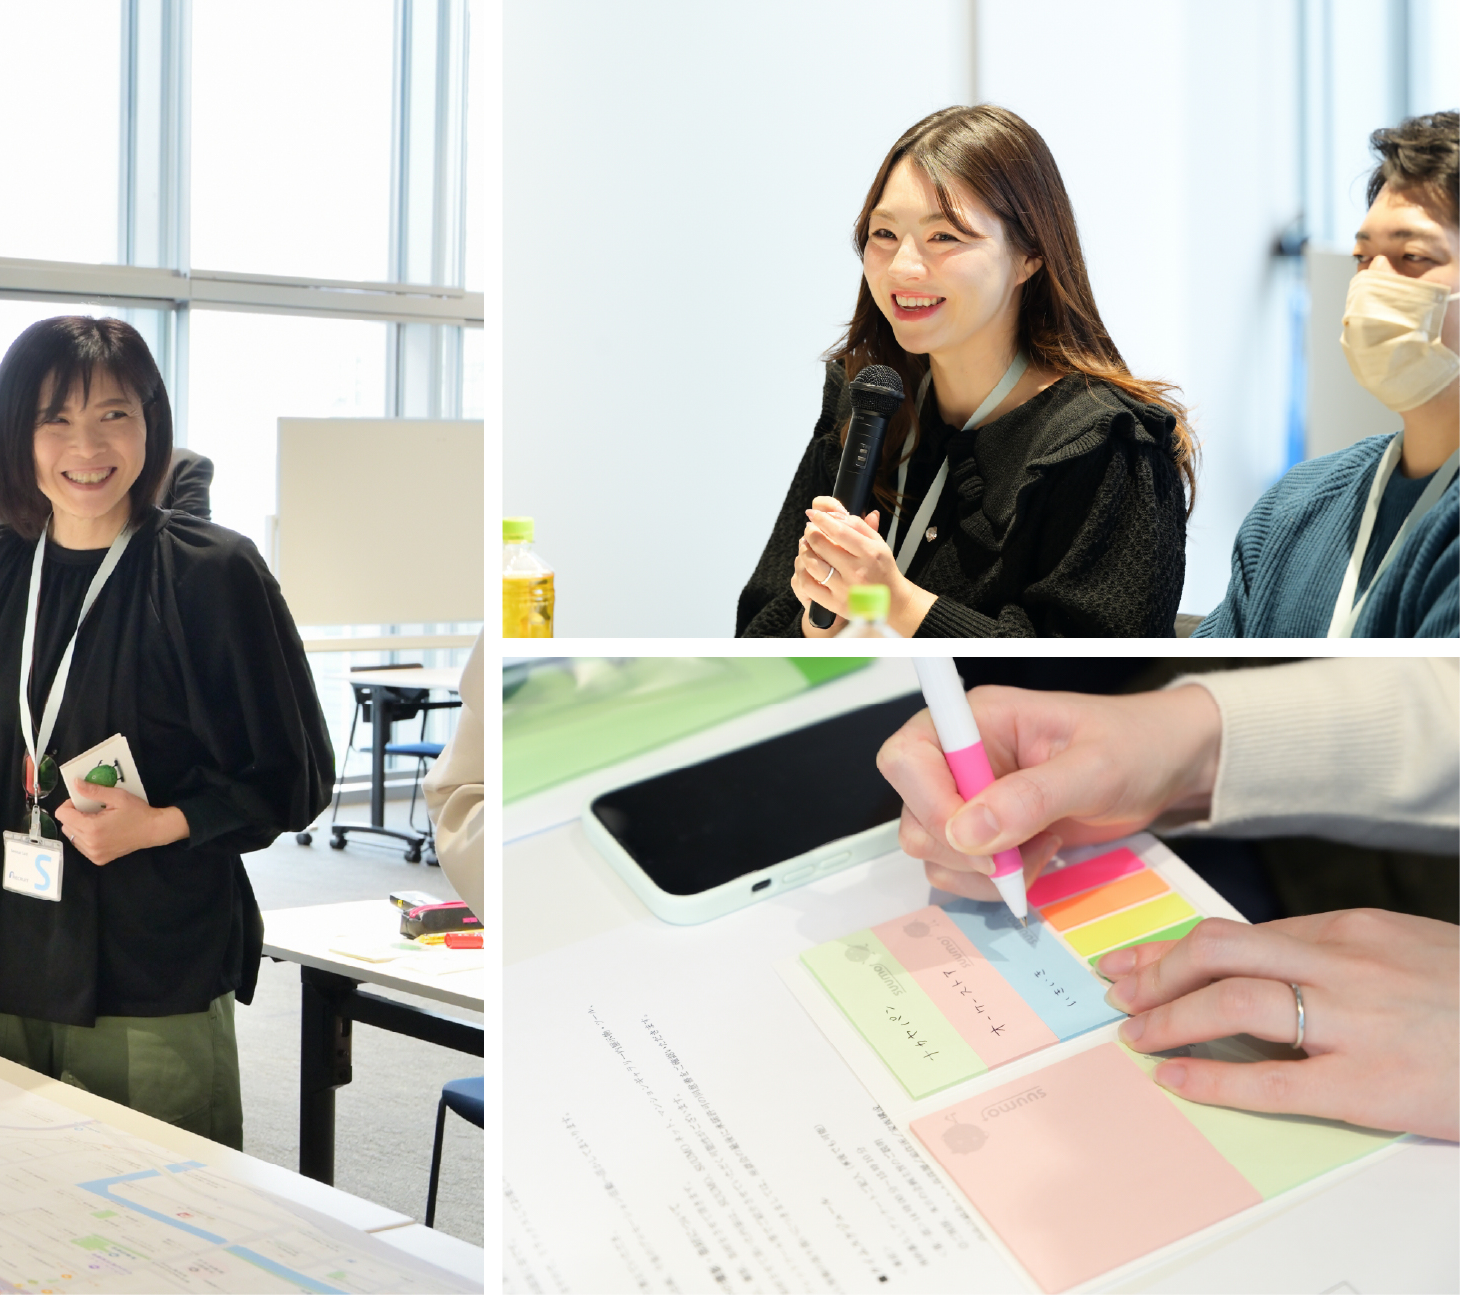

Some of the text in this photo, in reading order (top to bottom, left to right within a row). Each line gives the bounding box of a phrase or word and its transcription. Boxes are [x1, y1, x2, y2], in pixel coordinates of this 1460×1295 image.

[34, 854, 52, 891] S
[942, 970, 1006, 1036] オーケーストア
[1034, 969, 1077, 1008] いきいき
[885, 1005, 939, 1061] ナカヤパン
